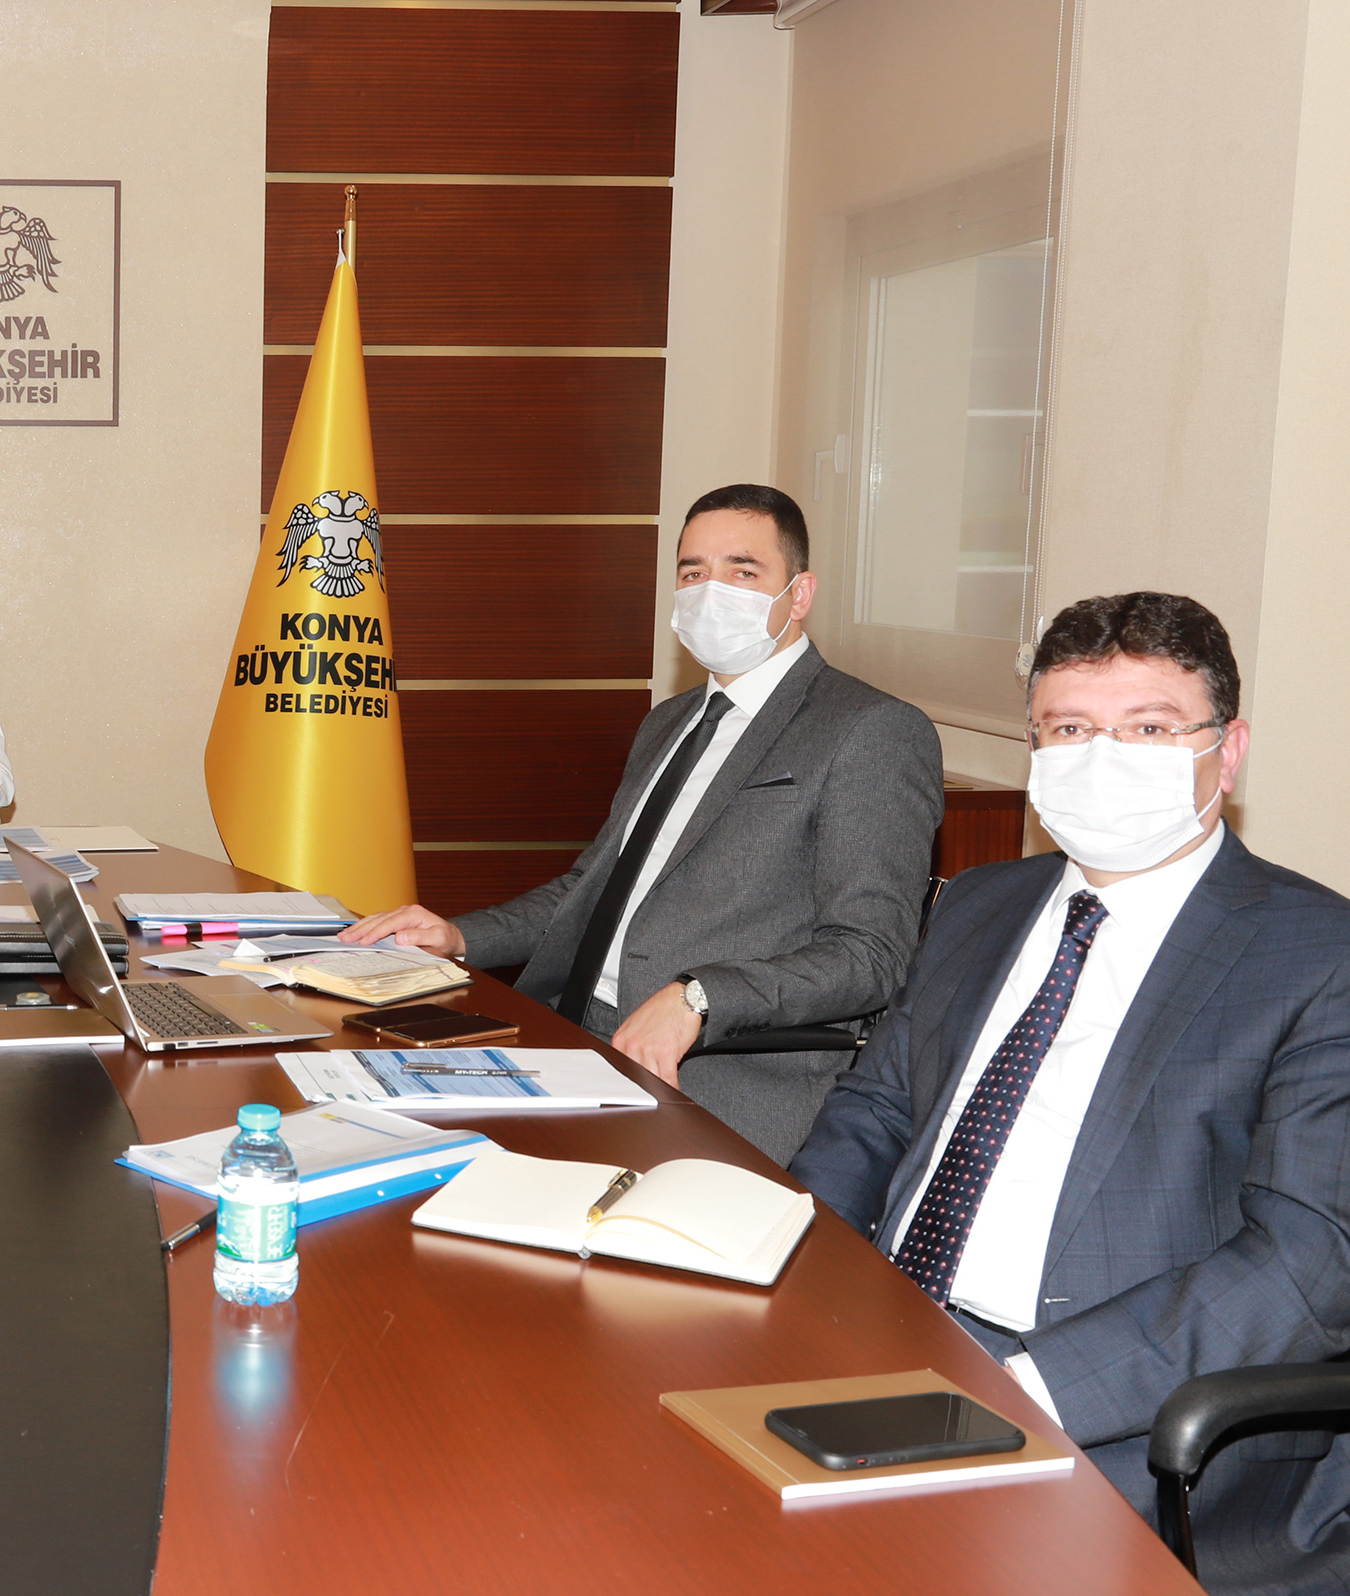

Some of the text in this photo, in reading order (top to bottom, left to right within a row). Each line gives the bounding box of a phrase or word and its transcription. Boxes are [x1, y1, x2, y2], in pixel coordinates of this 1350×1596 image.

[280, 612, 384, 646] KONYA
[234, 643, 397, 692] BÜYÜKŞEH
[265, 690, 388, 719] BELEDİYESİ
